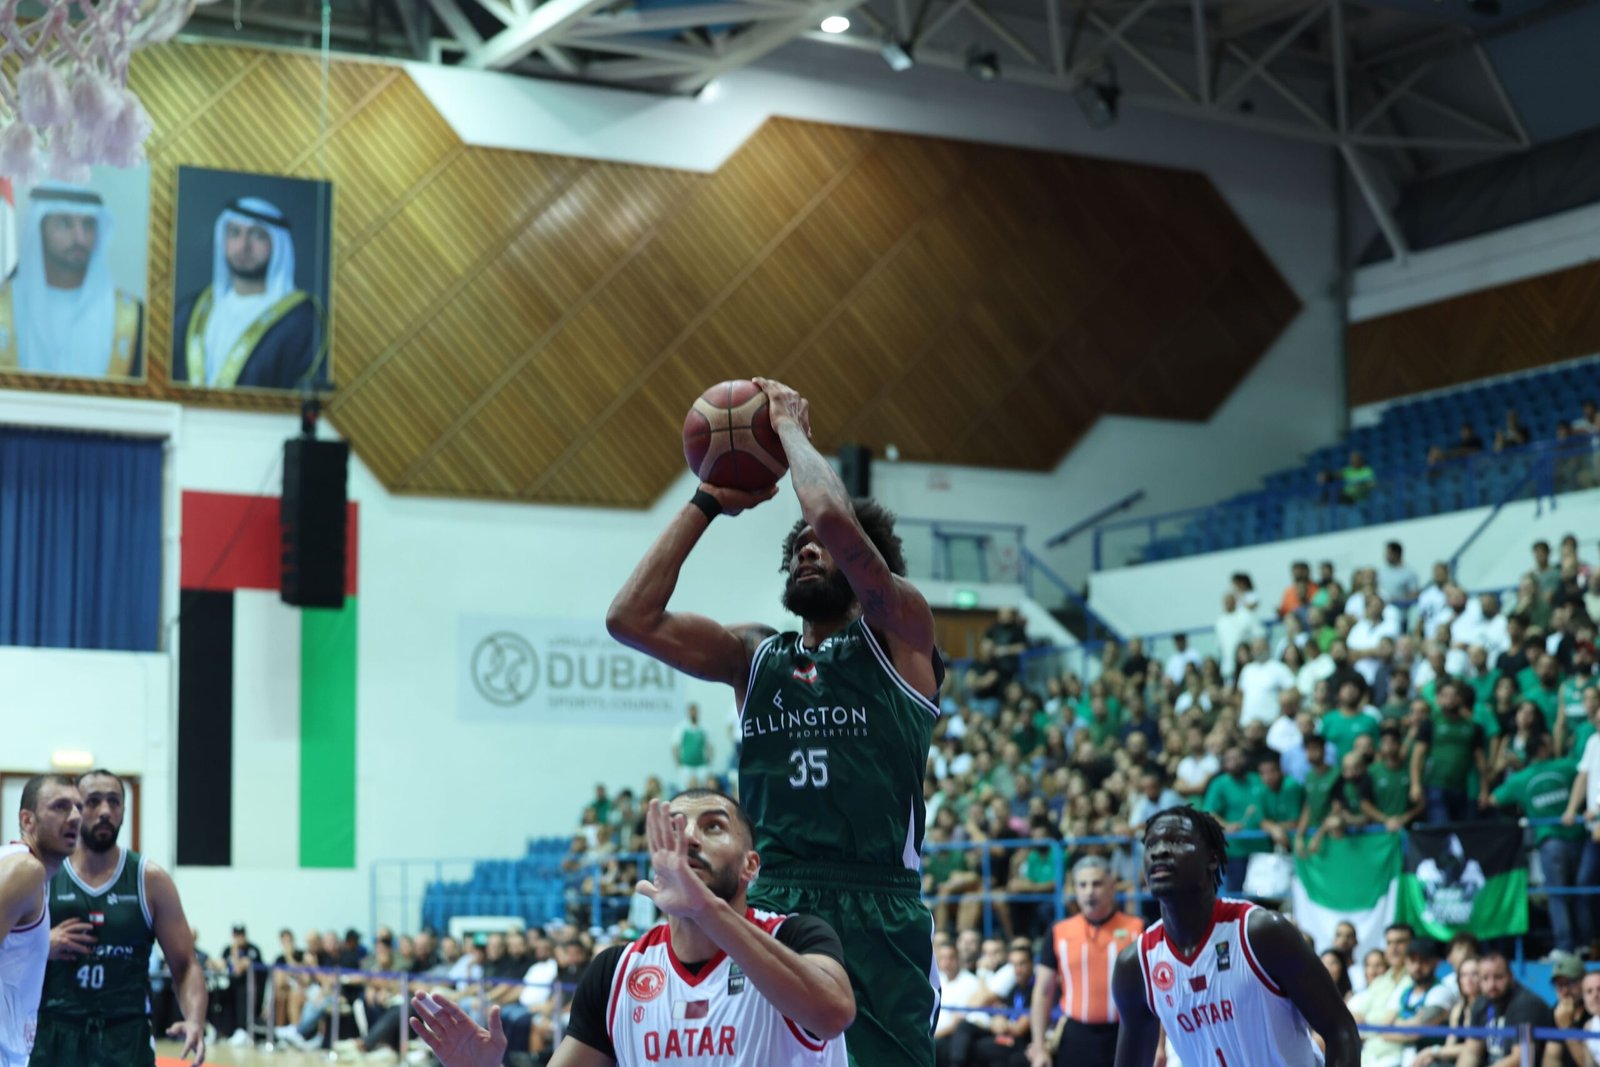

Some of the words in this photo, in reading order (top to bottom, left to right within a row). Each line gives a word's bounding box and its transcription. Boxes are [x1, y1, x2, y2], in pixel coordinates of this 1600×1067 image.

[547, 653, 675, 690] DUBAI
[744, 706, 867, 737] ELLINGTON
[789, 749, 829, 789] 35
[77, 964, 105, 989] 40
[1177, 1000, 1234, 1032] QATAR
[644, 1026, 736, 1062] QATAR
